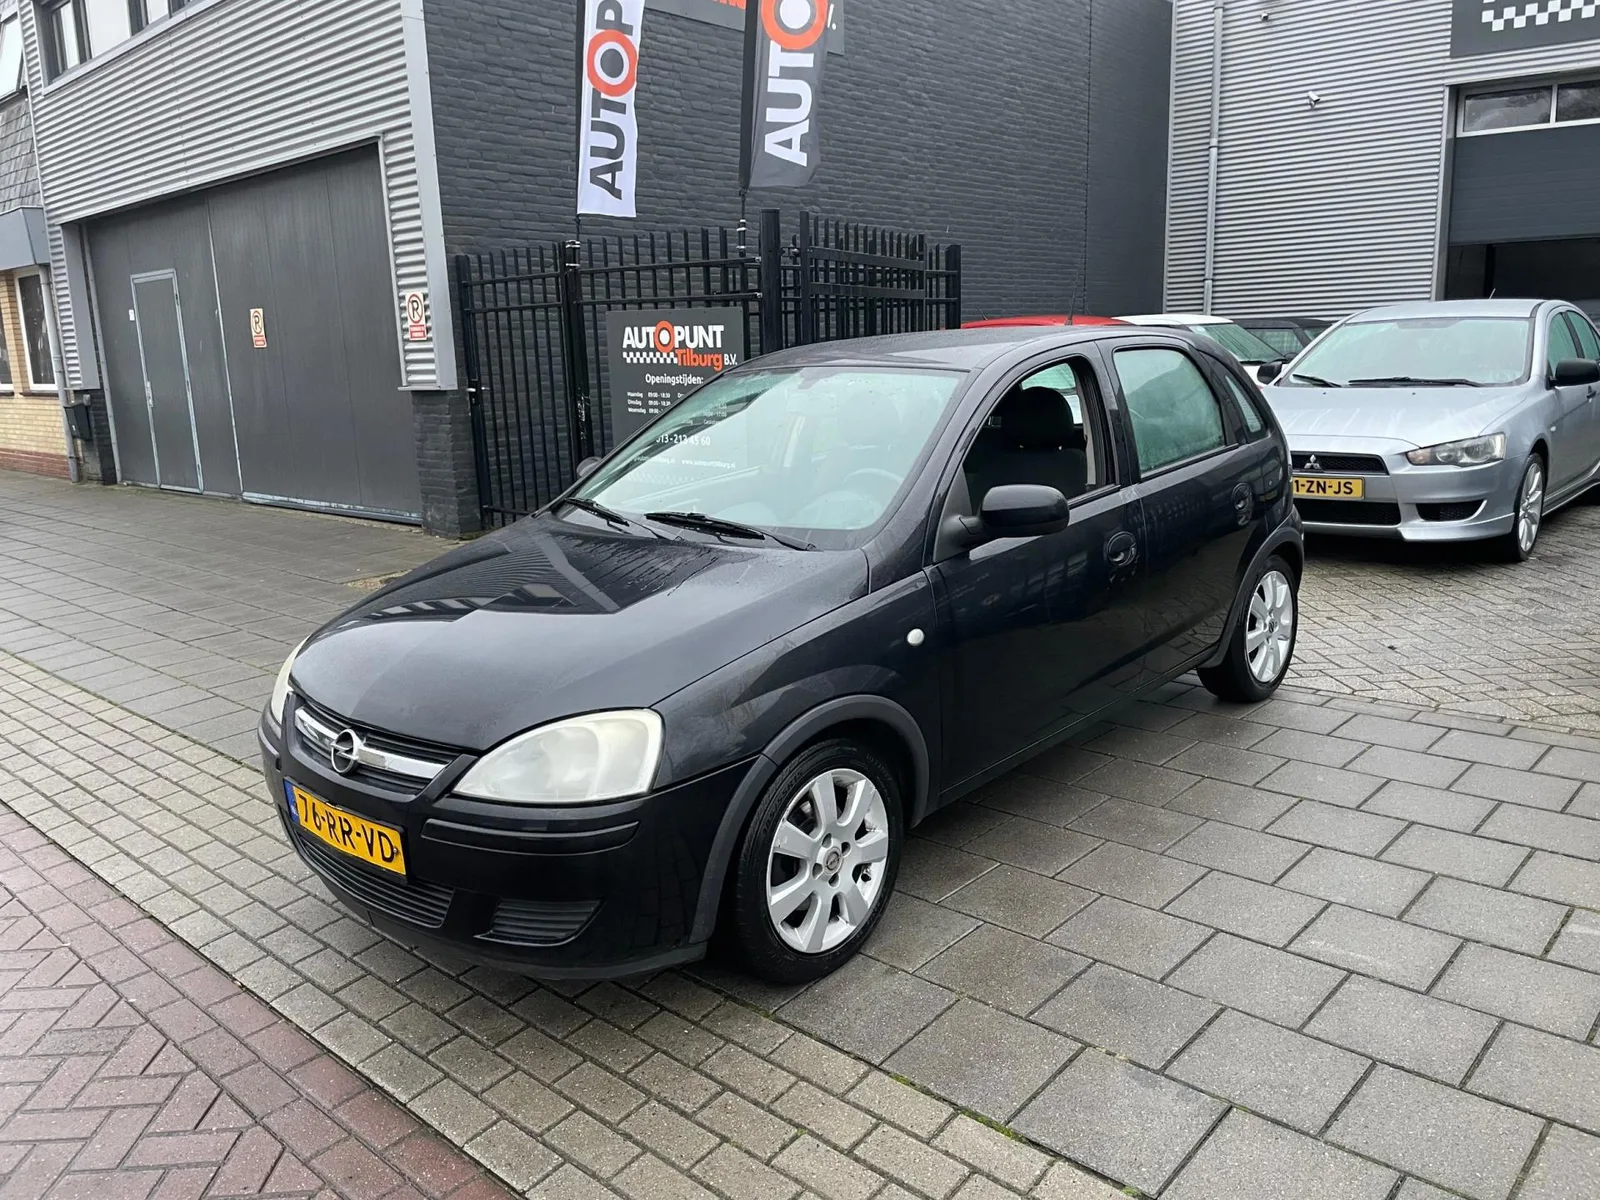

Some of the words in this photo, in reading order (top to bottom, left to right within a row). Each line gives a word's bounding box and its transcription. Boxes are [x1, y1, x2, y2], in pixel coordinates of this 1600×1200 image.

[622, 320, 725, 353] AUTOPUNT
[674, 348, 723, 372] Tilburg
[723, 353, 738, 366] B.V.
[645, 373, 704, 386] Openingstijden:
[1294, 479, 1354, 495] 1-ZN-JS
[298, 793, 395, 863] 76-RR-VD
